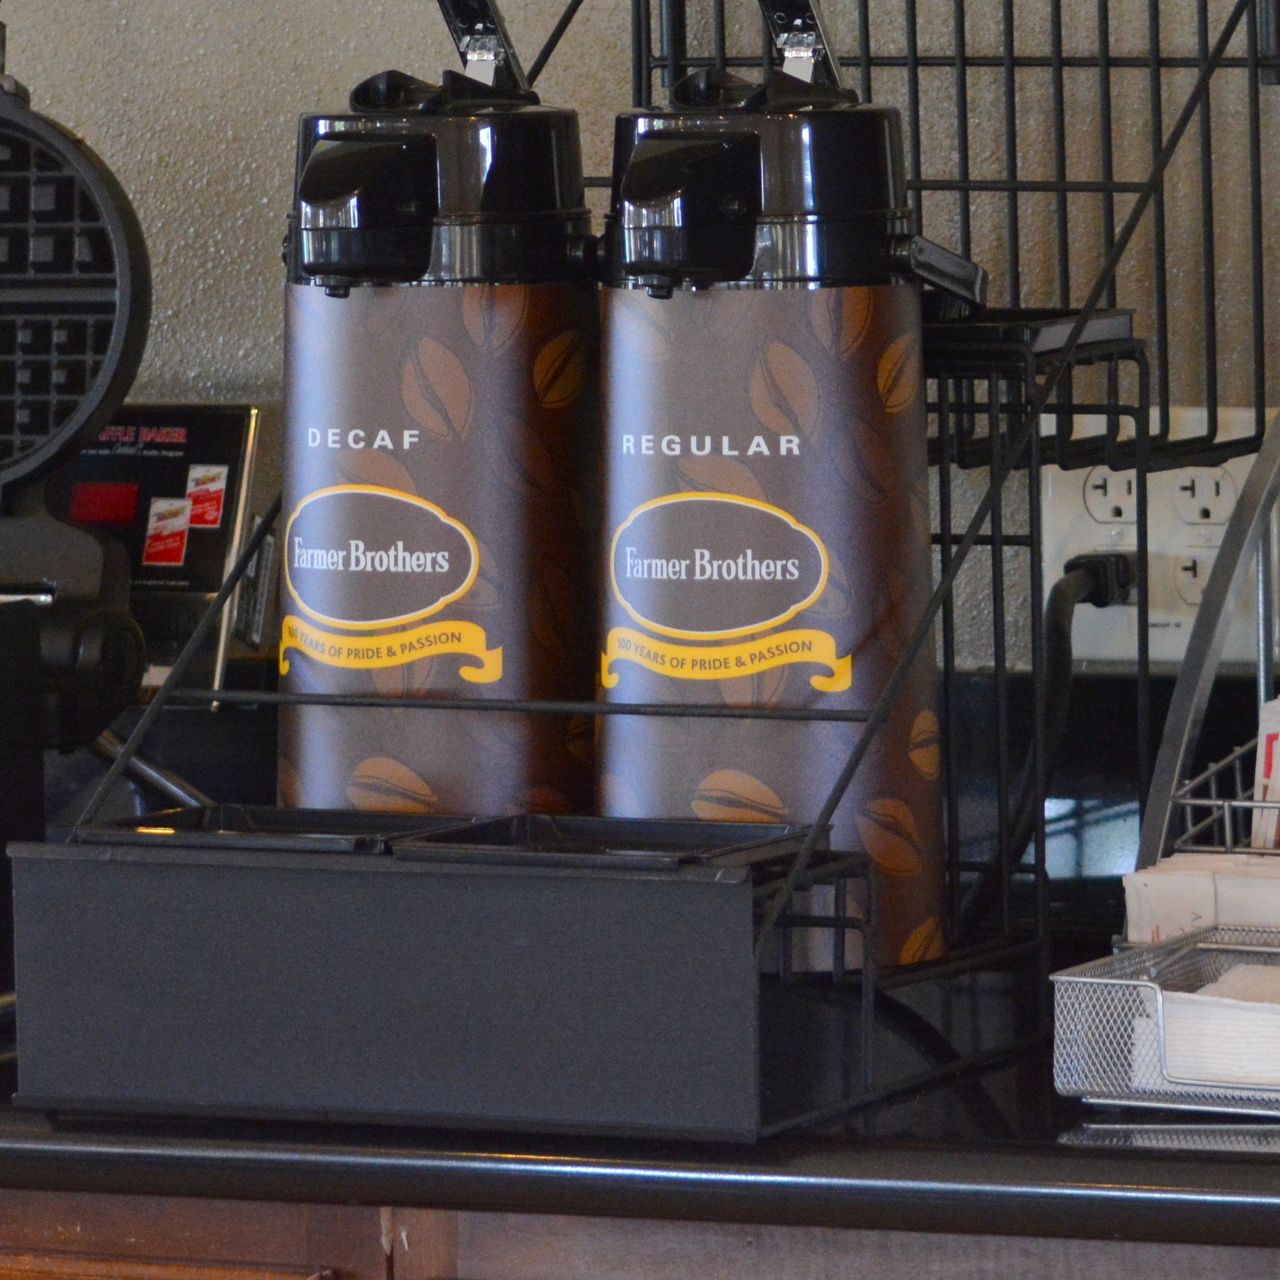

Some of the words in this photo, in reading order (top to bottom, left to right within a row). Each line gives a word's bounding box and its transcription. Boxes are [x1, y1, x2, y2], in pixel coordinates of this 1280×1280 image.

[307, 427, 420, 450] DECAF
[622, 434, 801, 456] REGULAR
[293, 536, 346, 571] Farmer
[349, 539, 450, 573] Brothers
[625, 546, 690, 580] Farmer
[693, 548, 800, 581] Brothers
[299, 630, 326, 654] YEARS
[328, 646, 344, 658] OF
[347, 647, 382, 660] PRIDE
[386, 645, 398, 657] &
[400, 631, 462, 654] PASSION
[634, 640, 667, 665] YEARS
[669, 657, 687, 669] OF
[691, 657, 731, 670] PRIDE
[735, 655, 746, 667] &
[749, 640, 813, 664] PASSION
